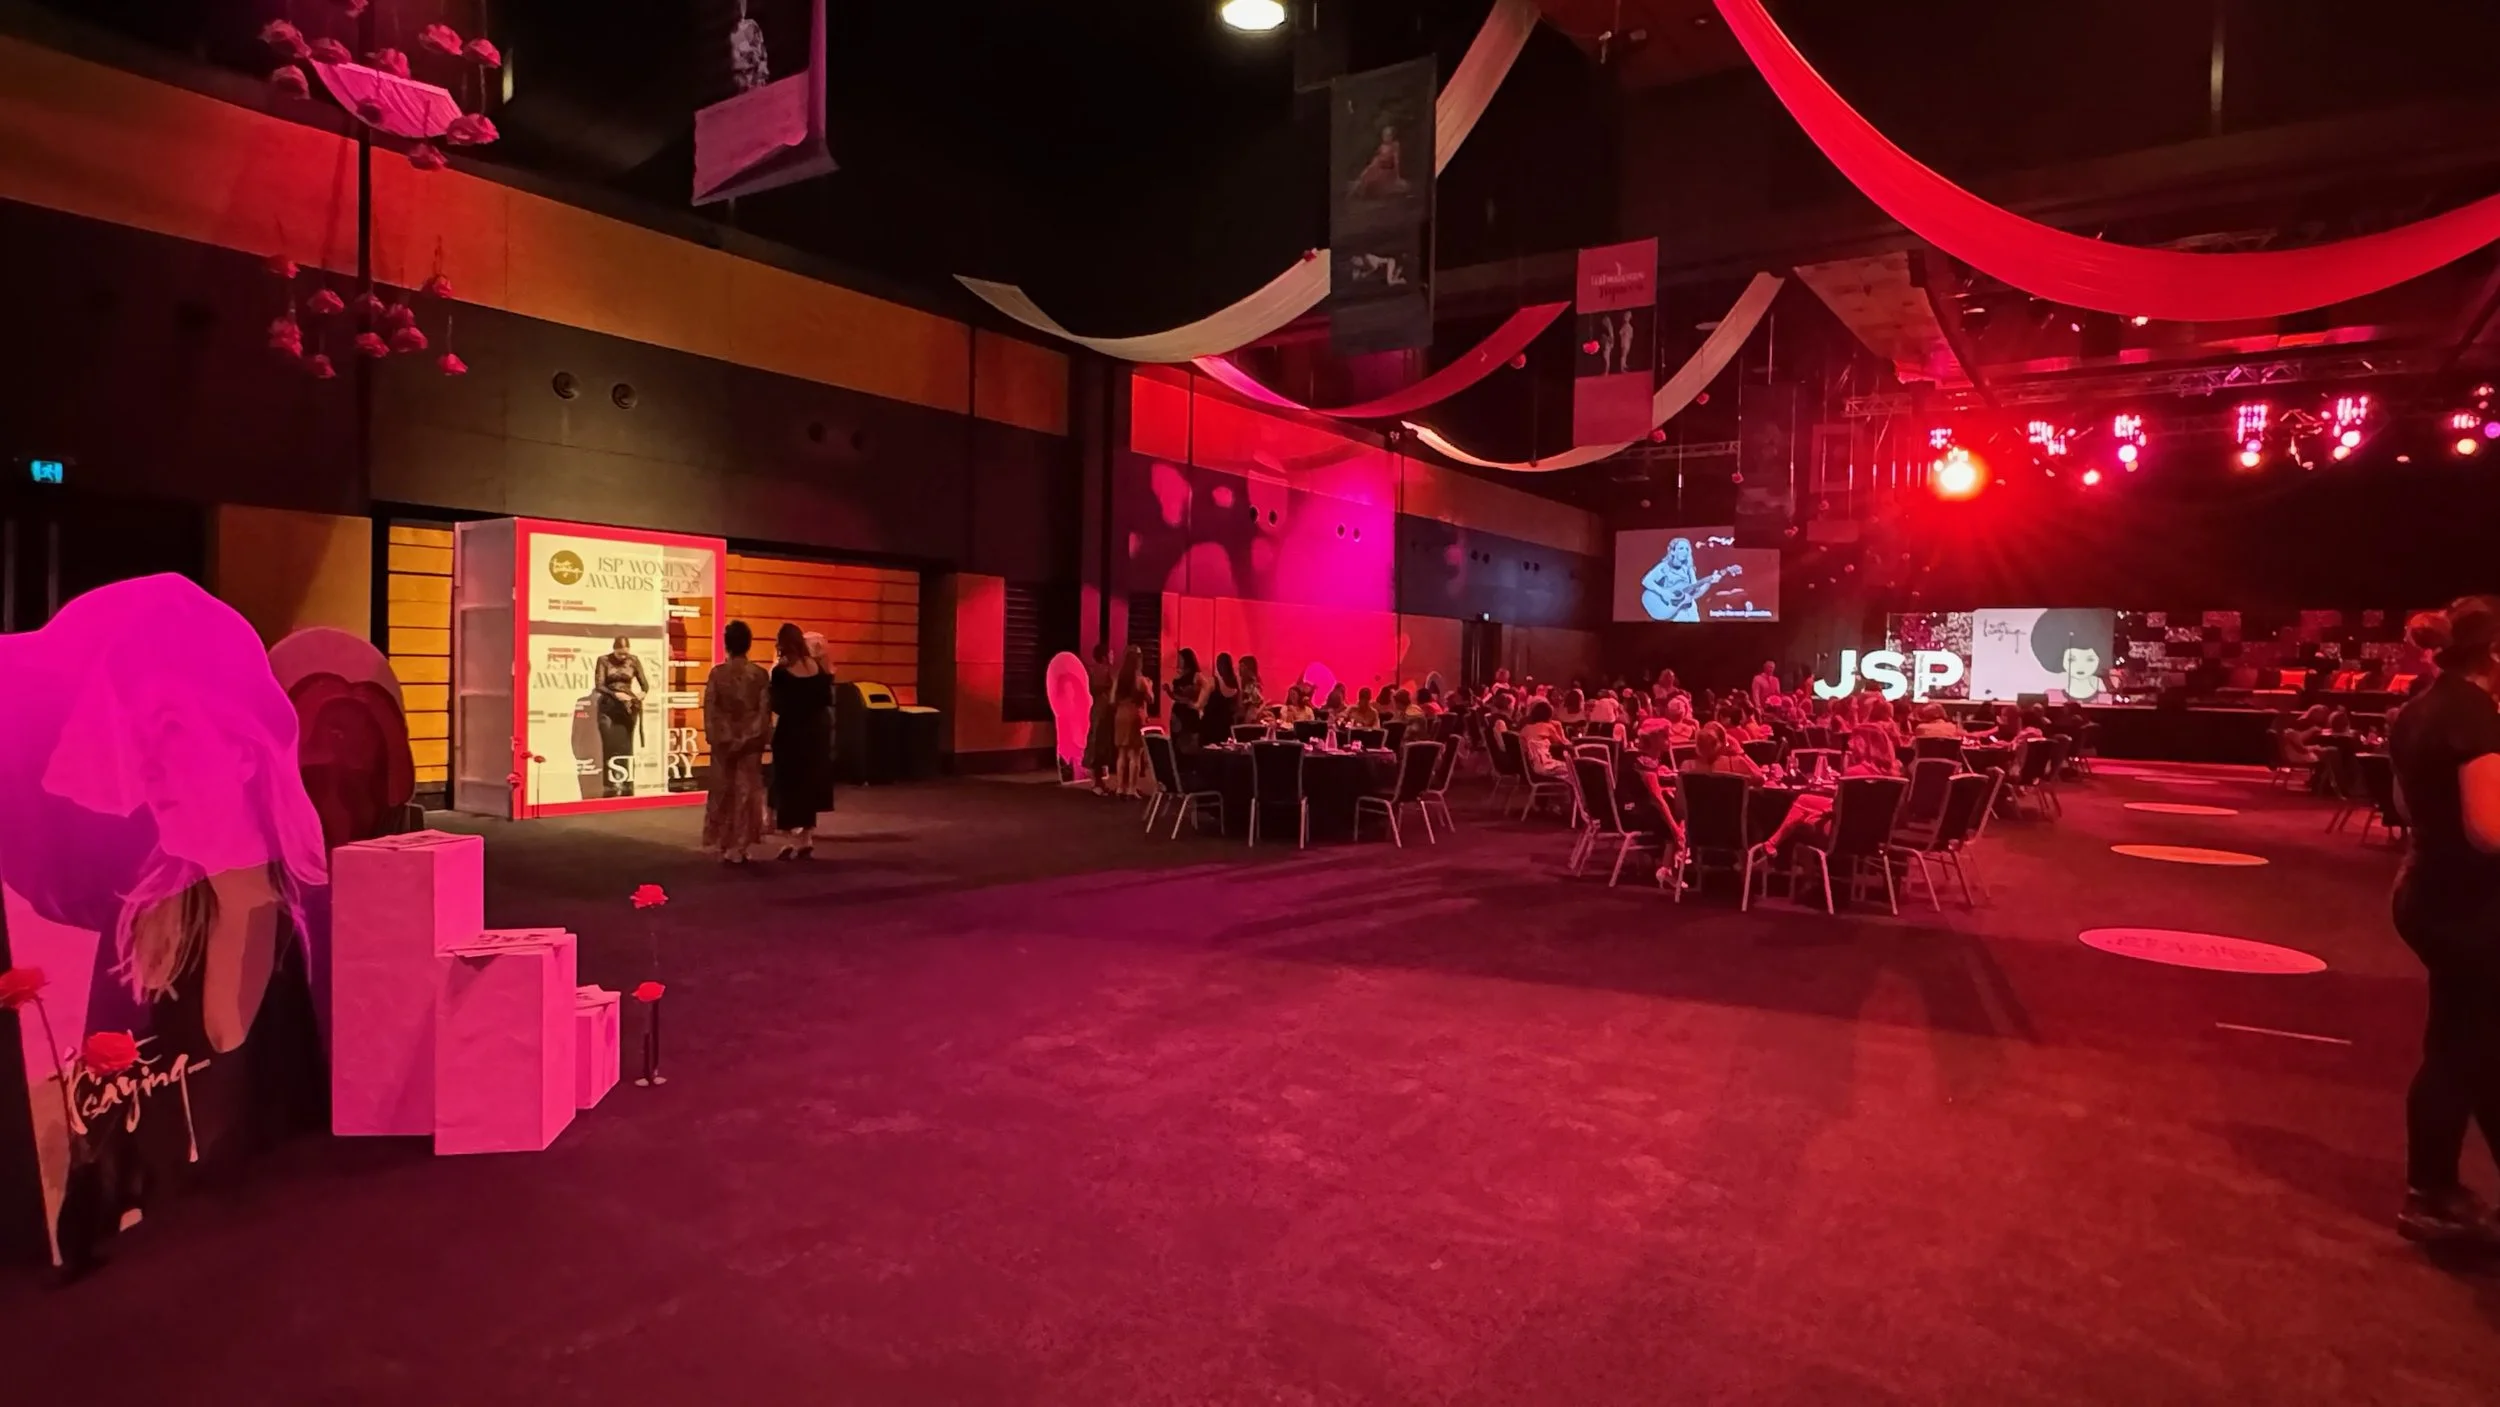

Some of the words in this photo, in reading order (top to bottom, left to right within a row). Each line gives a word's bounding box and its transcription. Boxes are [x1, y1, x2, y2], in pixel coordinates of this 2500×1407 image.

[598, 556, 624, 573] JSP
[585, 572, 654, 592] AWARDS
[1813, 648, 1965, 702] JSP
